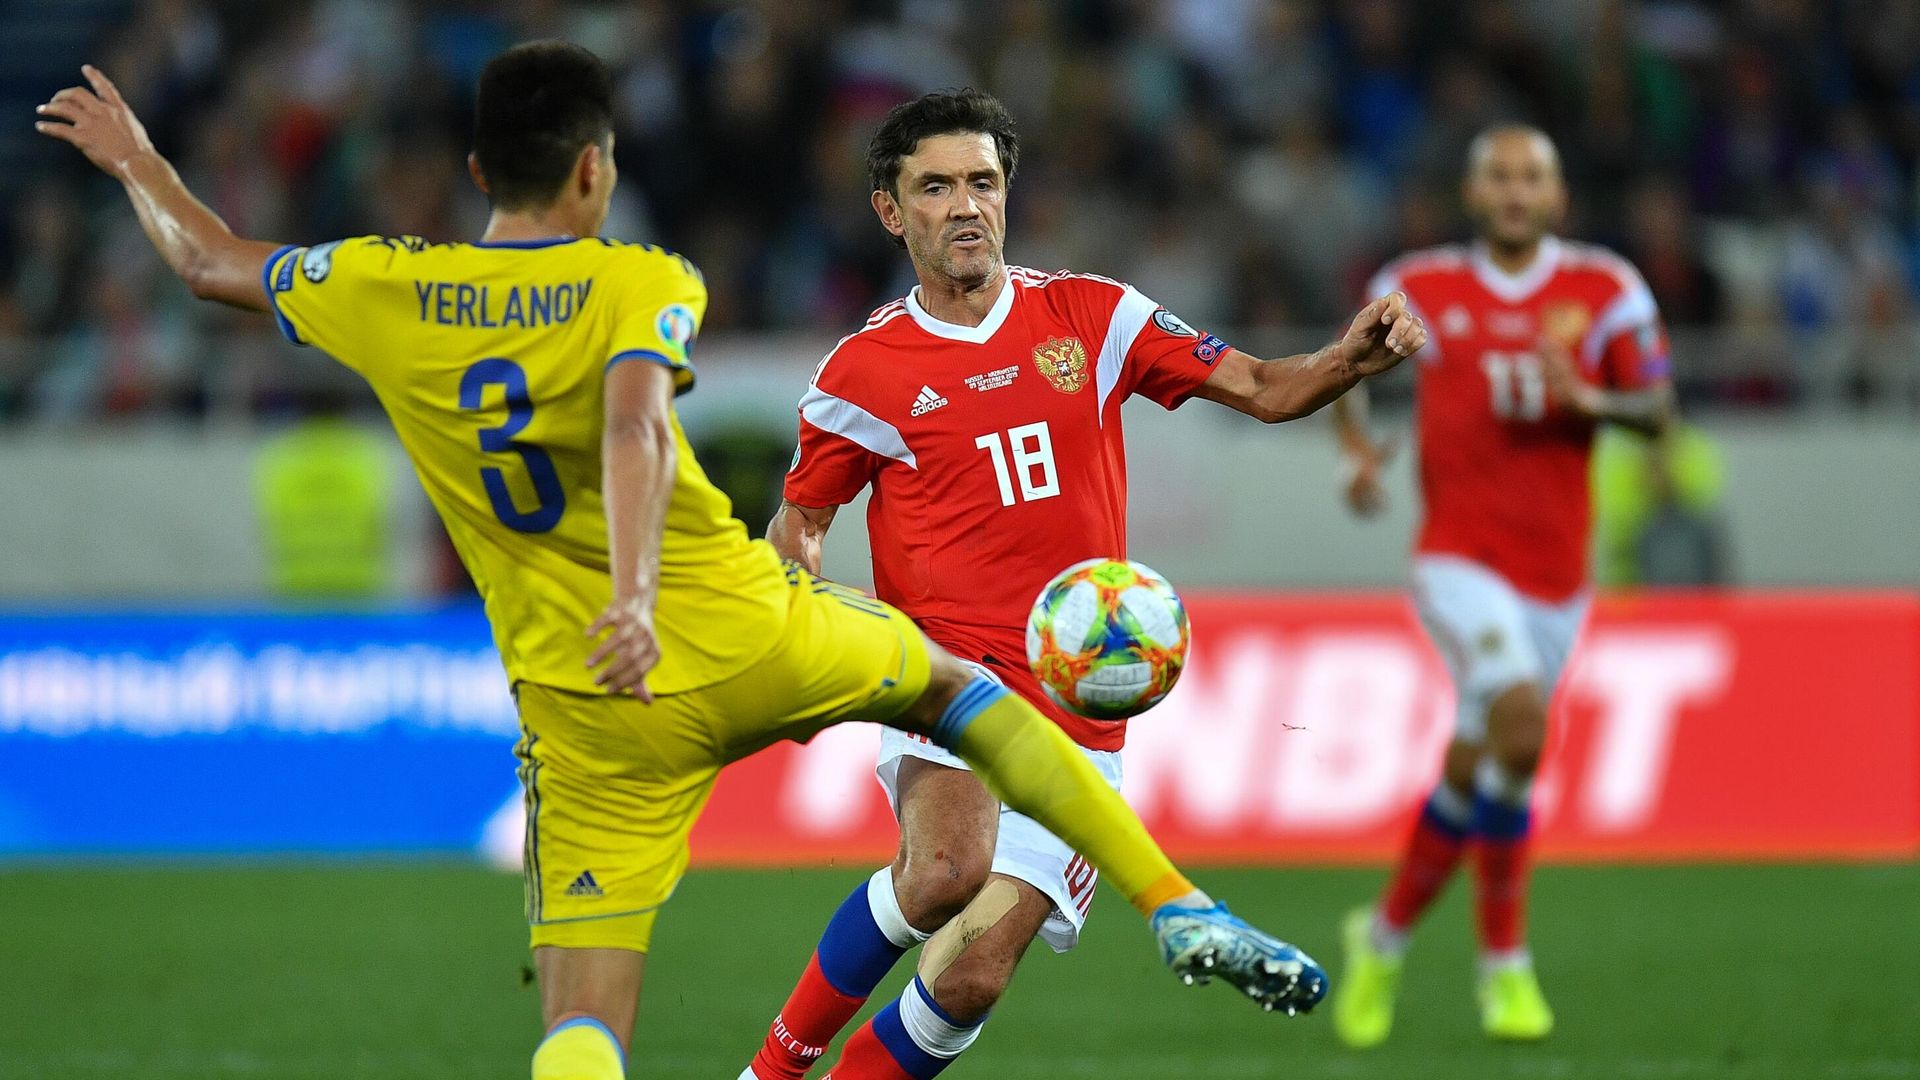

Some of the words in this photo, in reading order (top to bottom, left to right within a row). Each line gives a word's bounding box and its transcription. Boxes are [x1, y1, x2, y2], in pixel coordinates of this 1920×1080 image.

[414, 279, 593, 328] YERLANOV
[910, 397, 949, 417] adidas
[459, 357, 566, 534] 3
[974, 420, 1061, 507] 18
[773, 1013, 823, 1058] РОССИЯ
